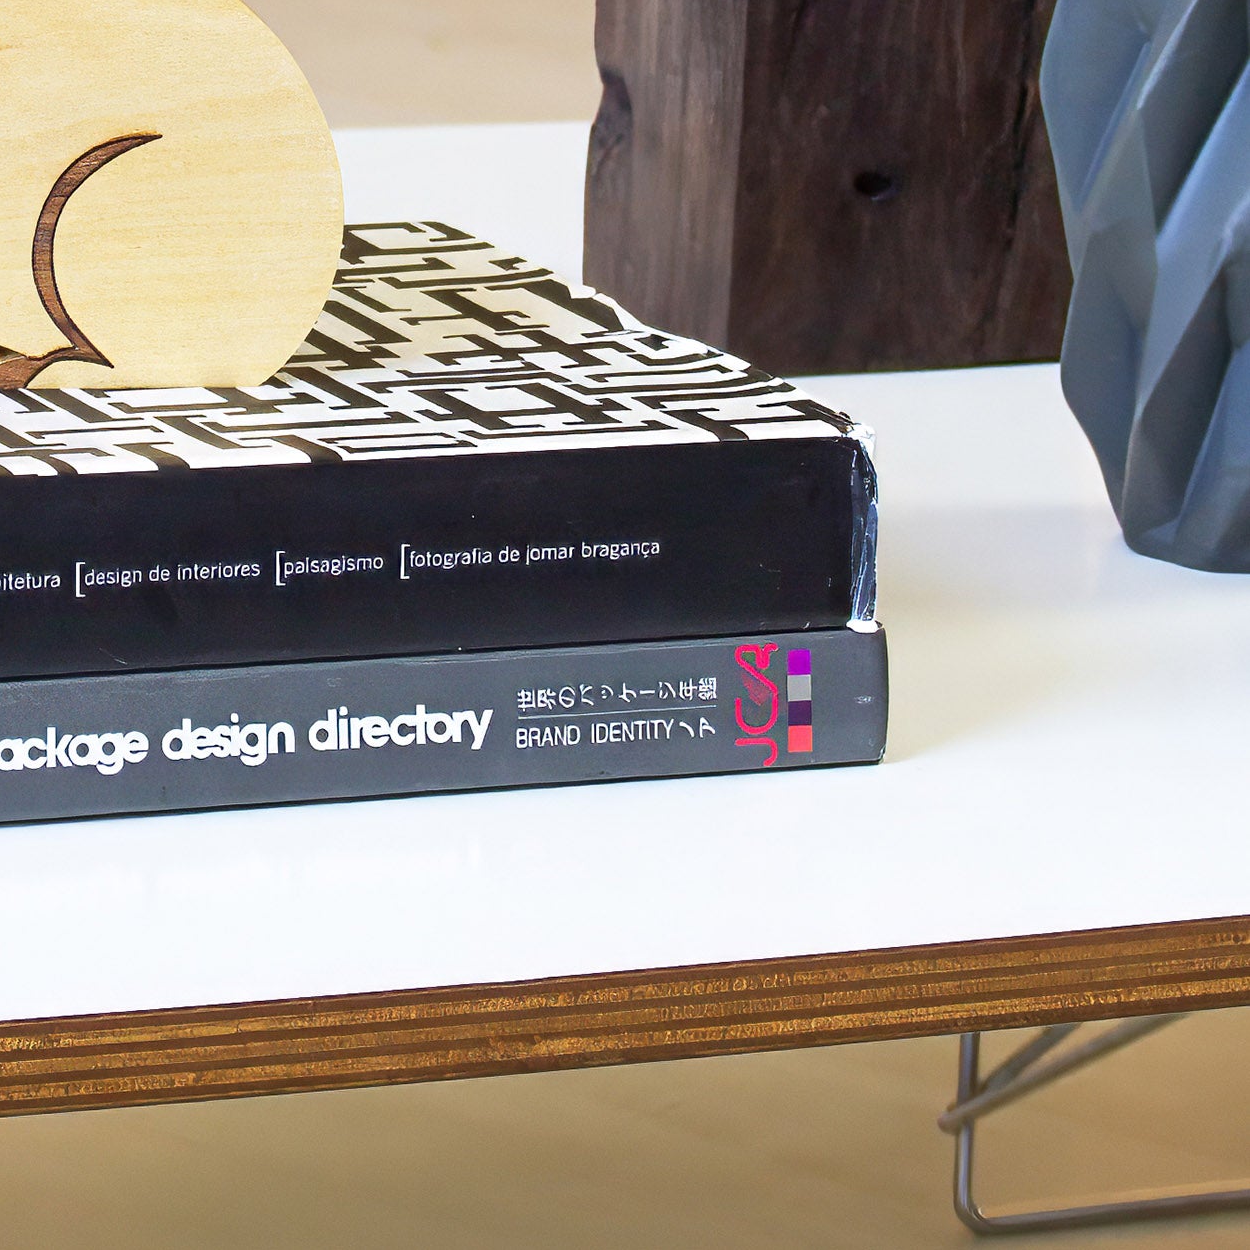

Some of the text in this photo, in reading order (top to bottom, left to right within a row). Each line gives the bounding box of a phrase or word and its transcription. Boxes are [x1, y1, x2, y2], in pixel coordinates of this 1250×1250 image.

[148, 564, 171, 582] de
[177, 563, 261, 581] interiores
[498, 545, 520, 563] de
[525, 546, 575, 566] jomar
[581, 541, 660, 561] bragança
[161, 712, 296, 767] design
[308, 704, 494, 751] directory
[515, 719, 675, 749] BRAND IDENTITY
